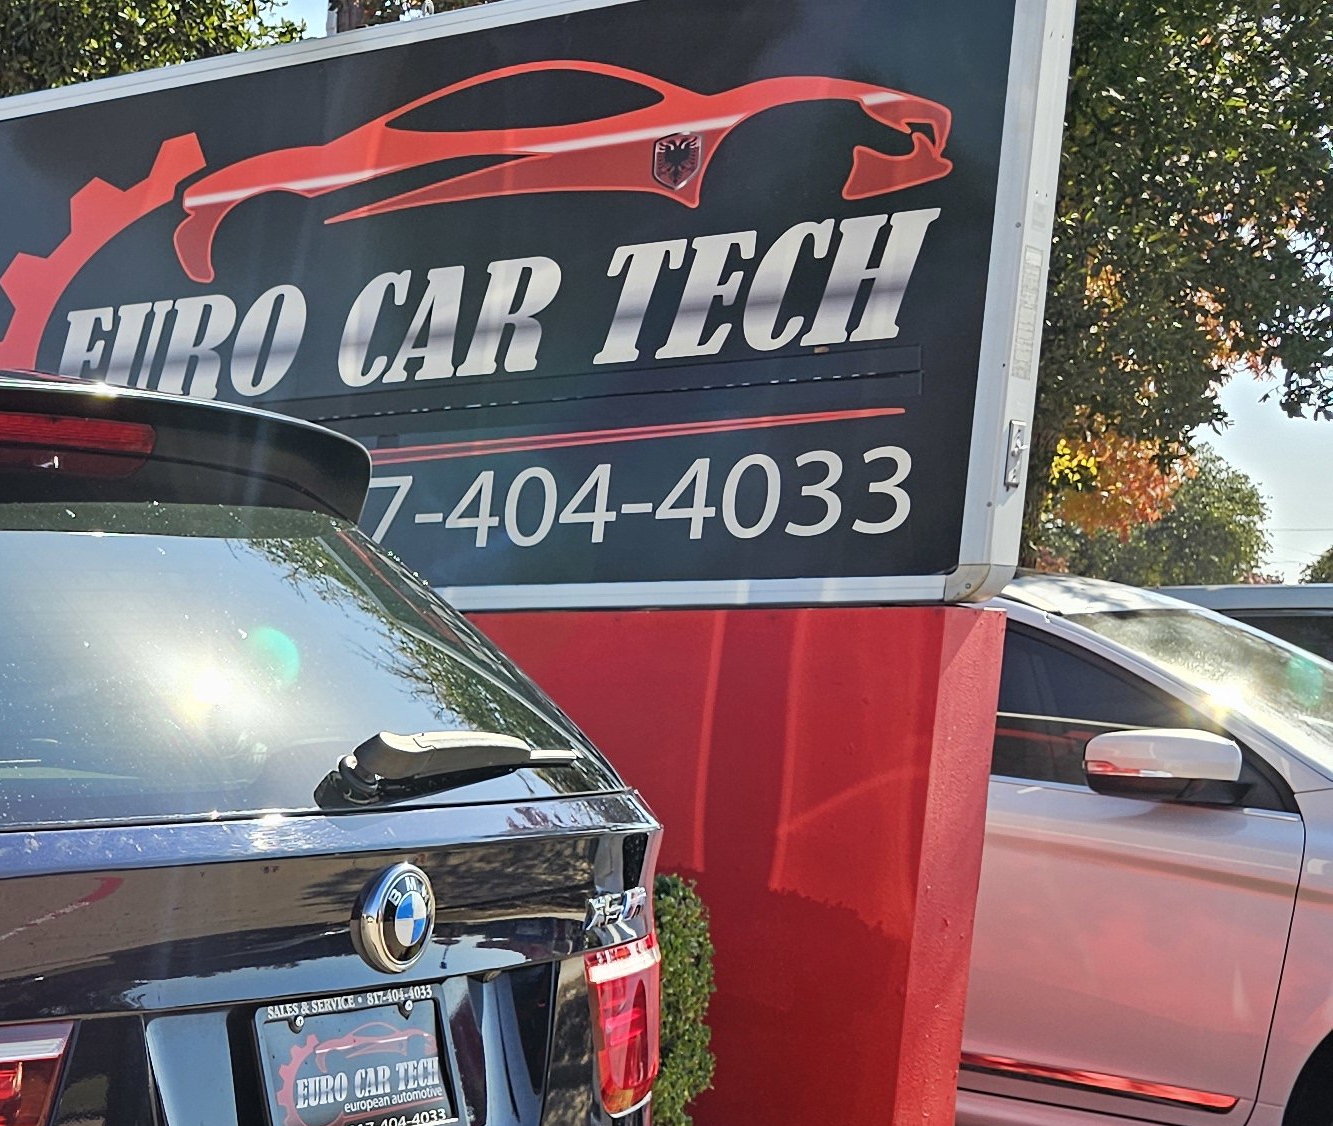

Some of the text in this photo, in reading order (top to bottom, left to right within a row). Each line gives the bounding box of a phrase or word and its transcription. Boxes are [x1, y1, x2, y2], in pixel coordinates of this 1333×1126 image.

[57, 284, 308, 400] EURO
[337, 255, 562, 387] CAR
[592, 207, 942, 365] TECH
[267, 984, 433, 1020] SALES & SERVICE 817-404-4033
[296, 1056, 439, 1109] EURO CAR TECH
[344, 1086, 443, 1113] european automotive
